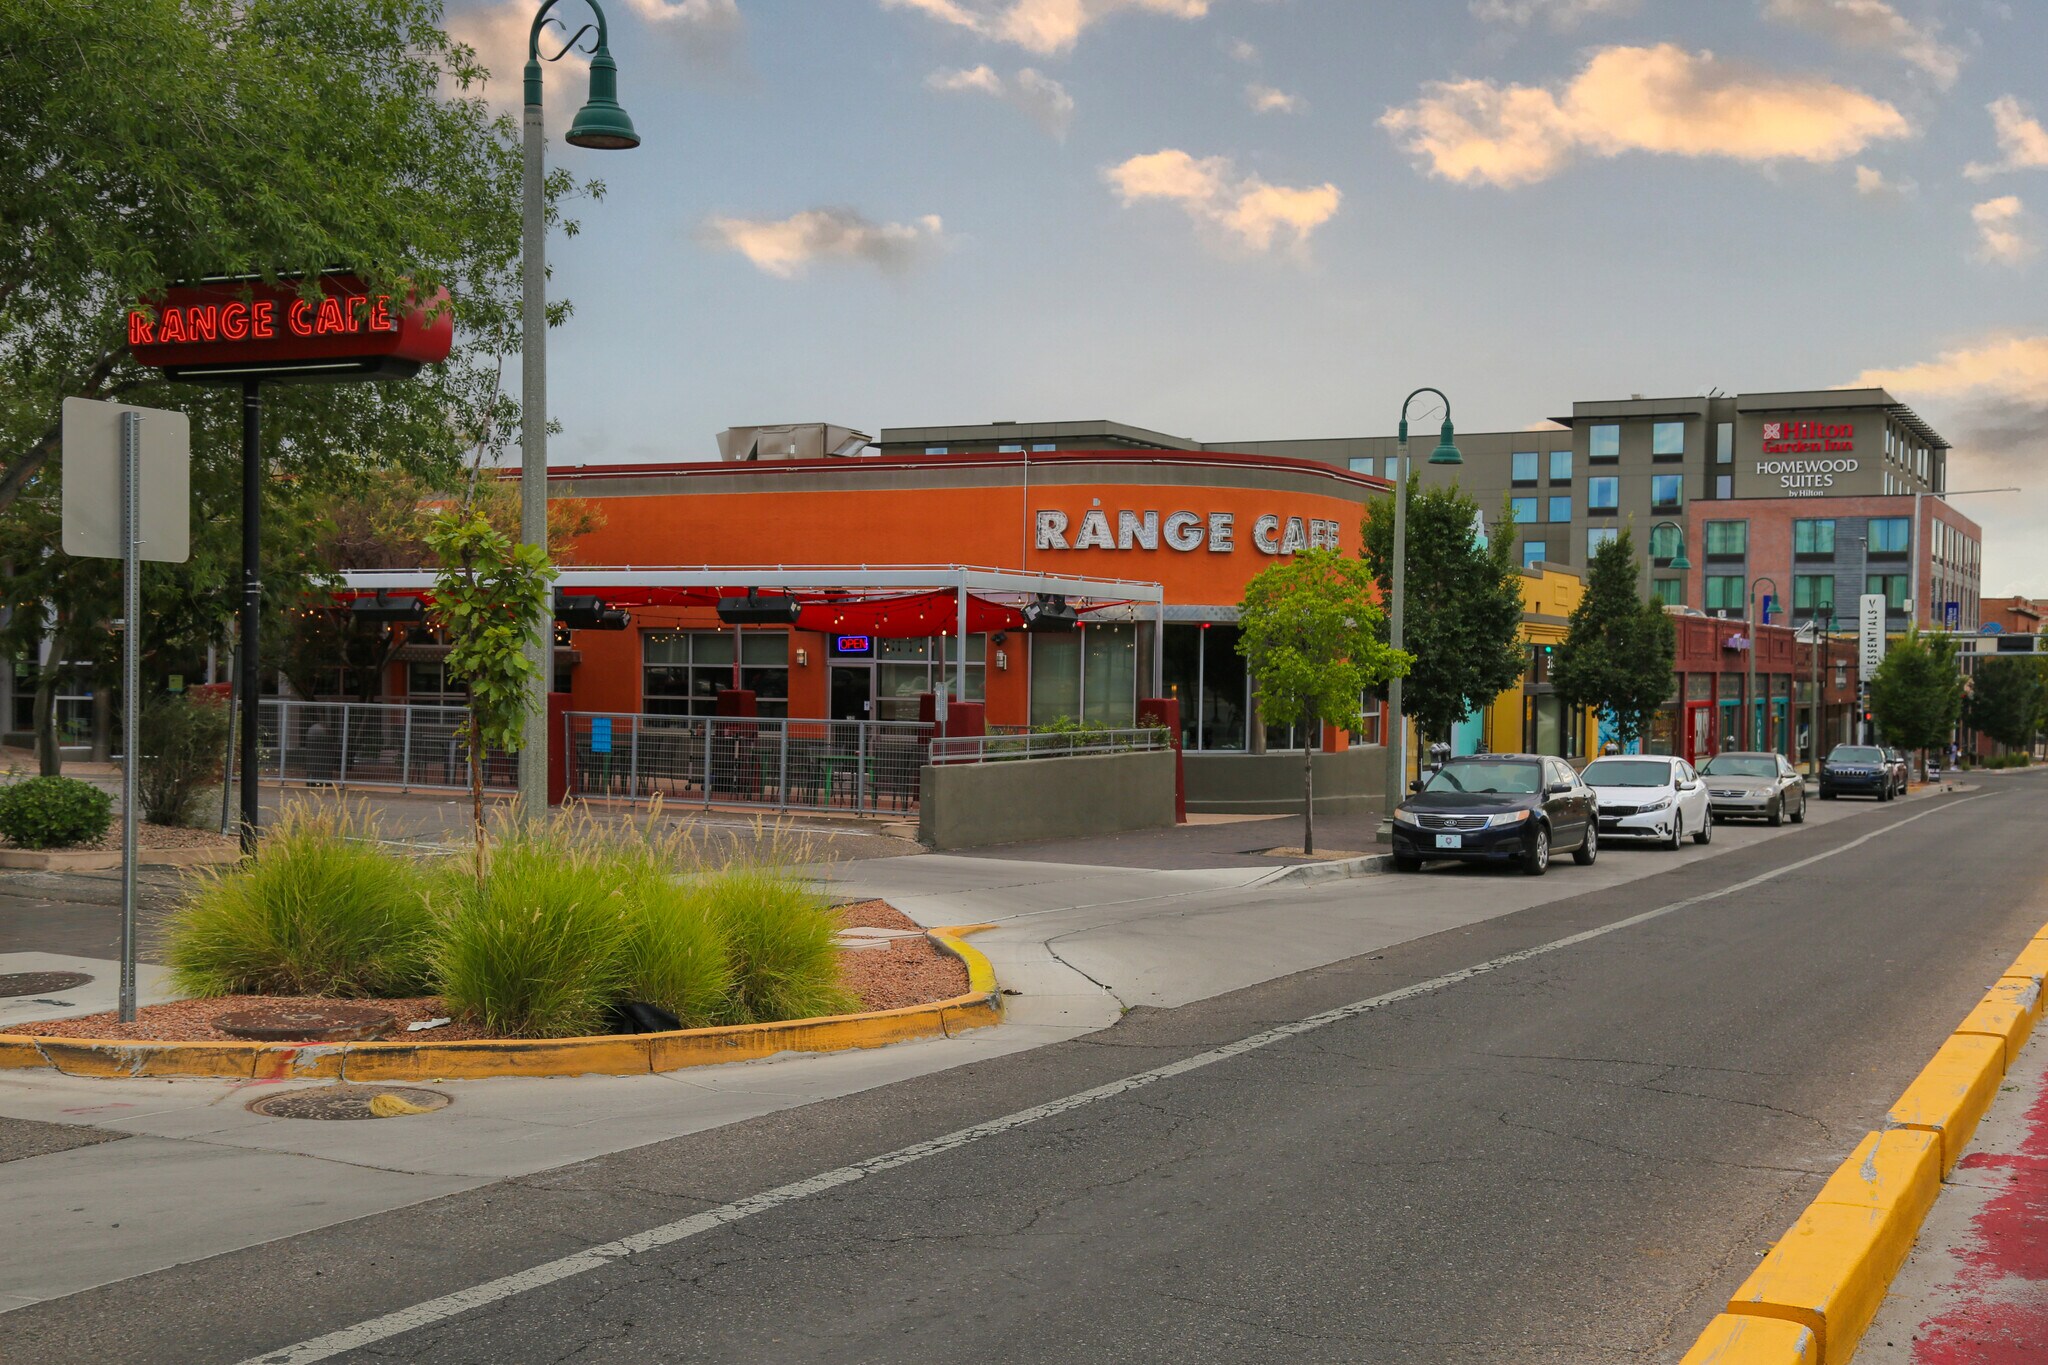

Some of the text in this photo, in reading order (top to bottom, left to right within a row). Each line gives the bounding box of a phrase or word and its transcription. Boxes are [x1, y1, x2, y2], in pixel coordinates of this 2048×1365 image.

[129, 295, 393, 344] RANGE CAFE
[1783, 421, 1854, 440] Hilton
[1763, 439, 1854, 453] Garden Inn
[1756, 459, 1859, 474] HOMEWOOD
[1780, 474, 1833, 488] SUITES
[1799, 489, 1824, 497] Hilton
[1035, 509, 1234, 552] RANGE
[841, 638, 868, 650] OPEN
[1867, 610, 1878, 665] ESSENTIALS
